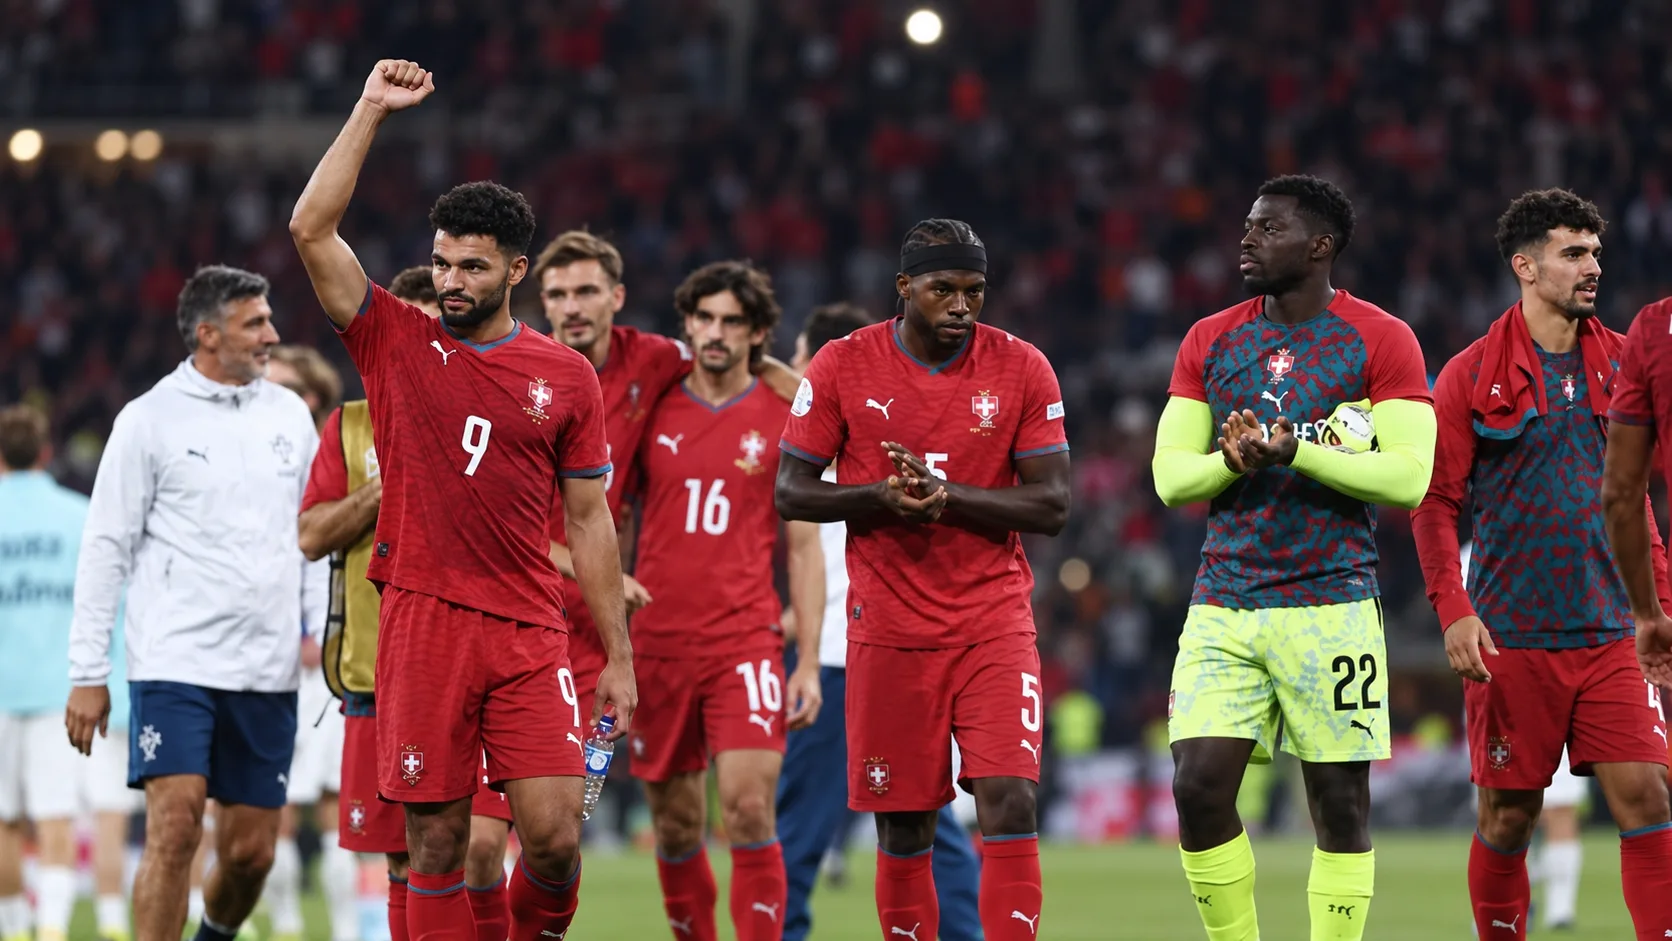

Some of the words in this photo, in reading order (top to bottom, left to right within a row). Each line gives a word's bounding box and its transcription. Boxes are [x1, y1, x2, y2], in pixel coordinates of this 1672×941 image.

[461, 415, 492, 477] 9
[685, 478, 731, 535] 16
[556, 667, 580, 728] 9
[735, 659, 782, 712] 16
[1020, 671, 1041, 733] 5
[1331, 653, 1382, 711] 22
